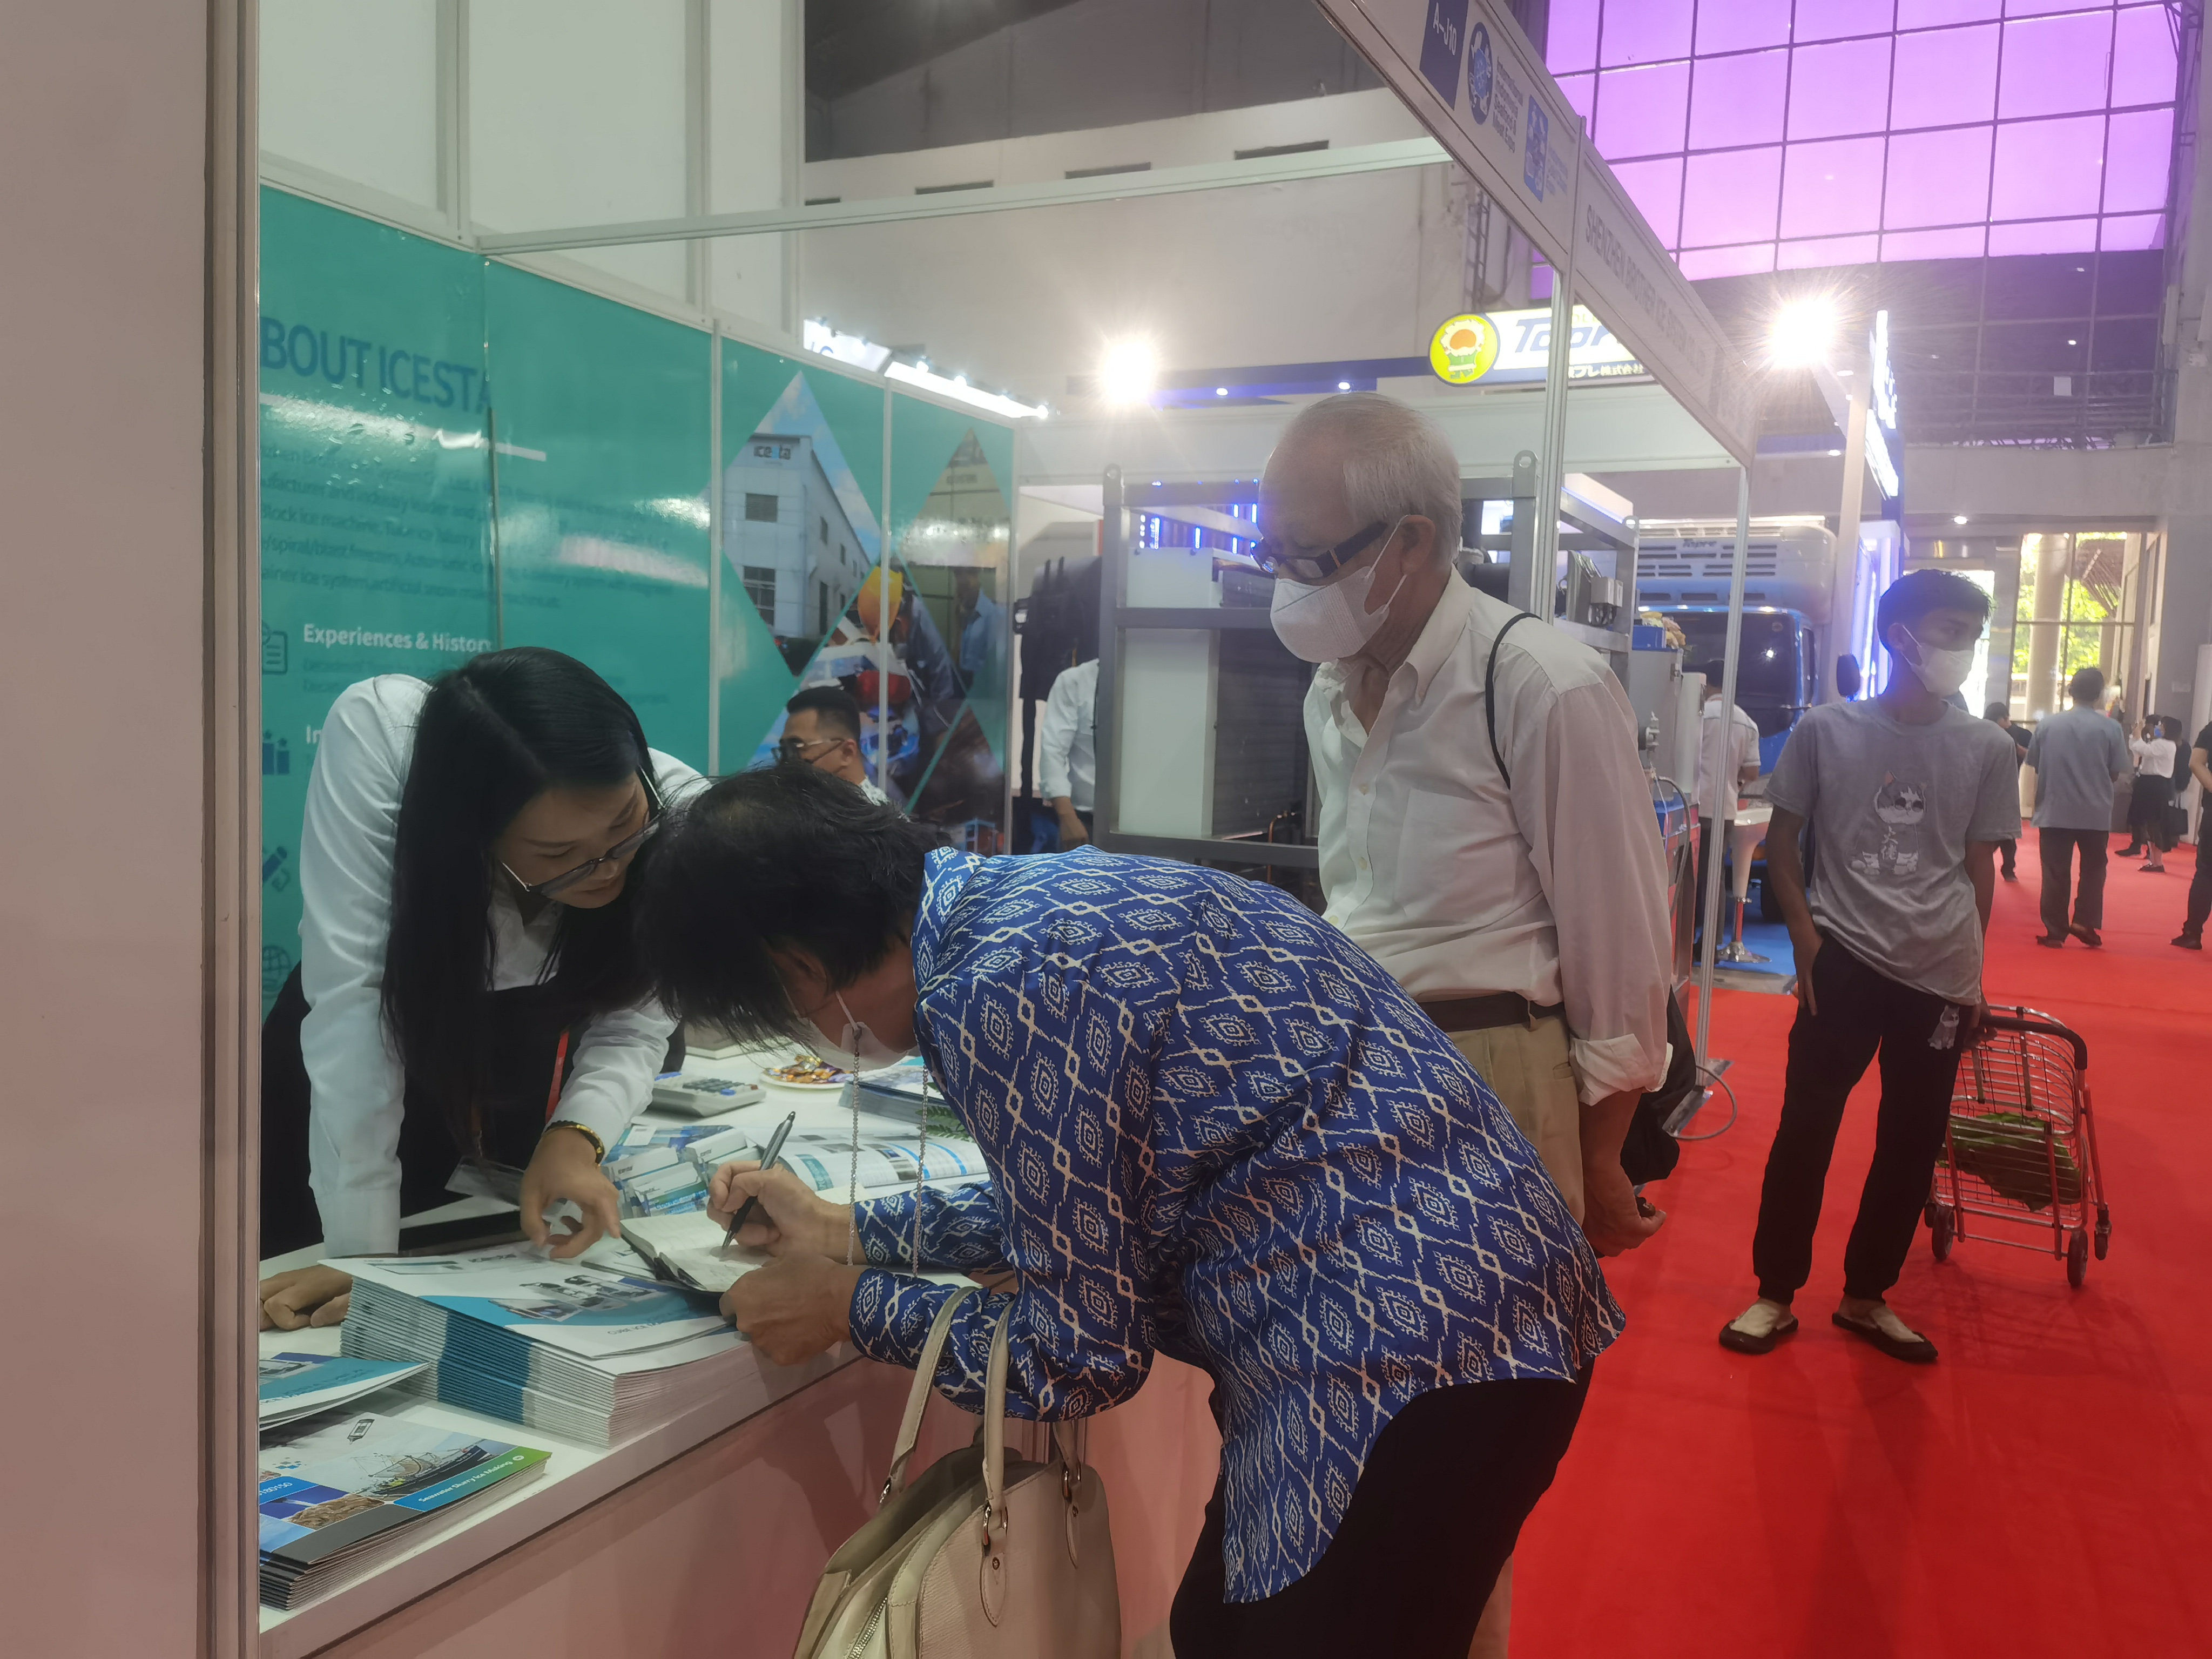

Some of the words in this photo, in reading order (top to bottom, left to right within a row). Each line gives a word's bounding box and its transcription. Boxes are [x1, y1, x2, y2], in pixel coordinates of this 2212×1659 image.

[1433, 2, 1457, 56] A-J10
[304, 623, 412, 649] Experiences
[415, 632, 429, 650] &
